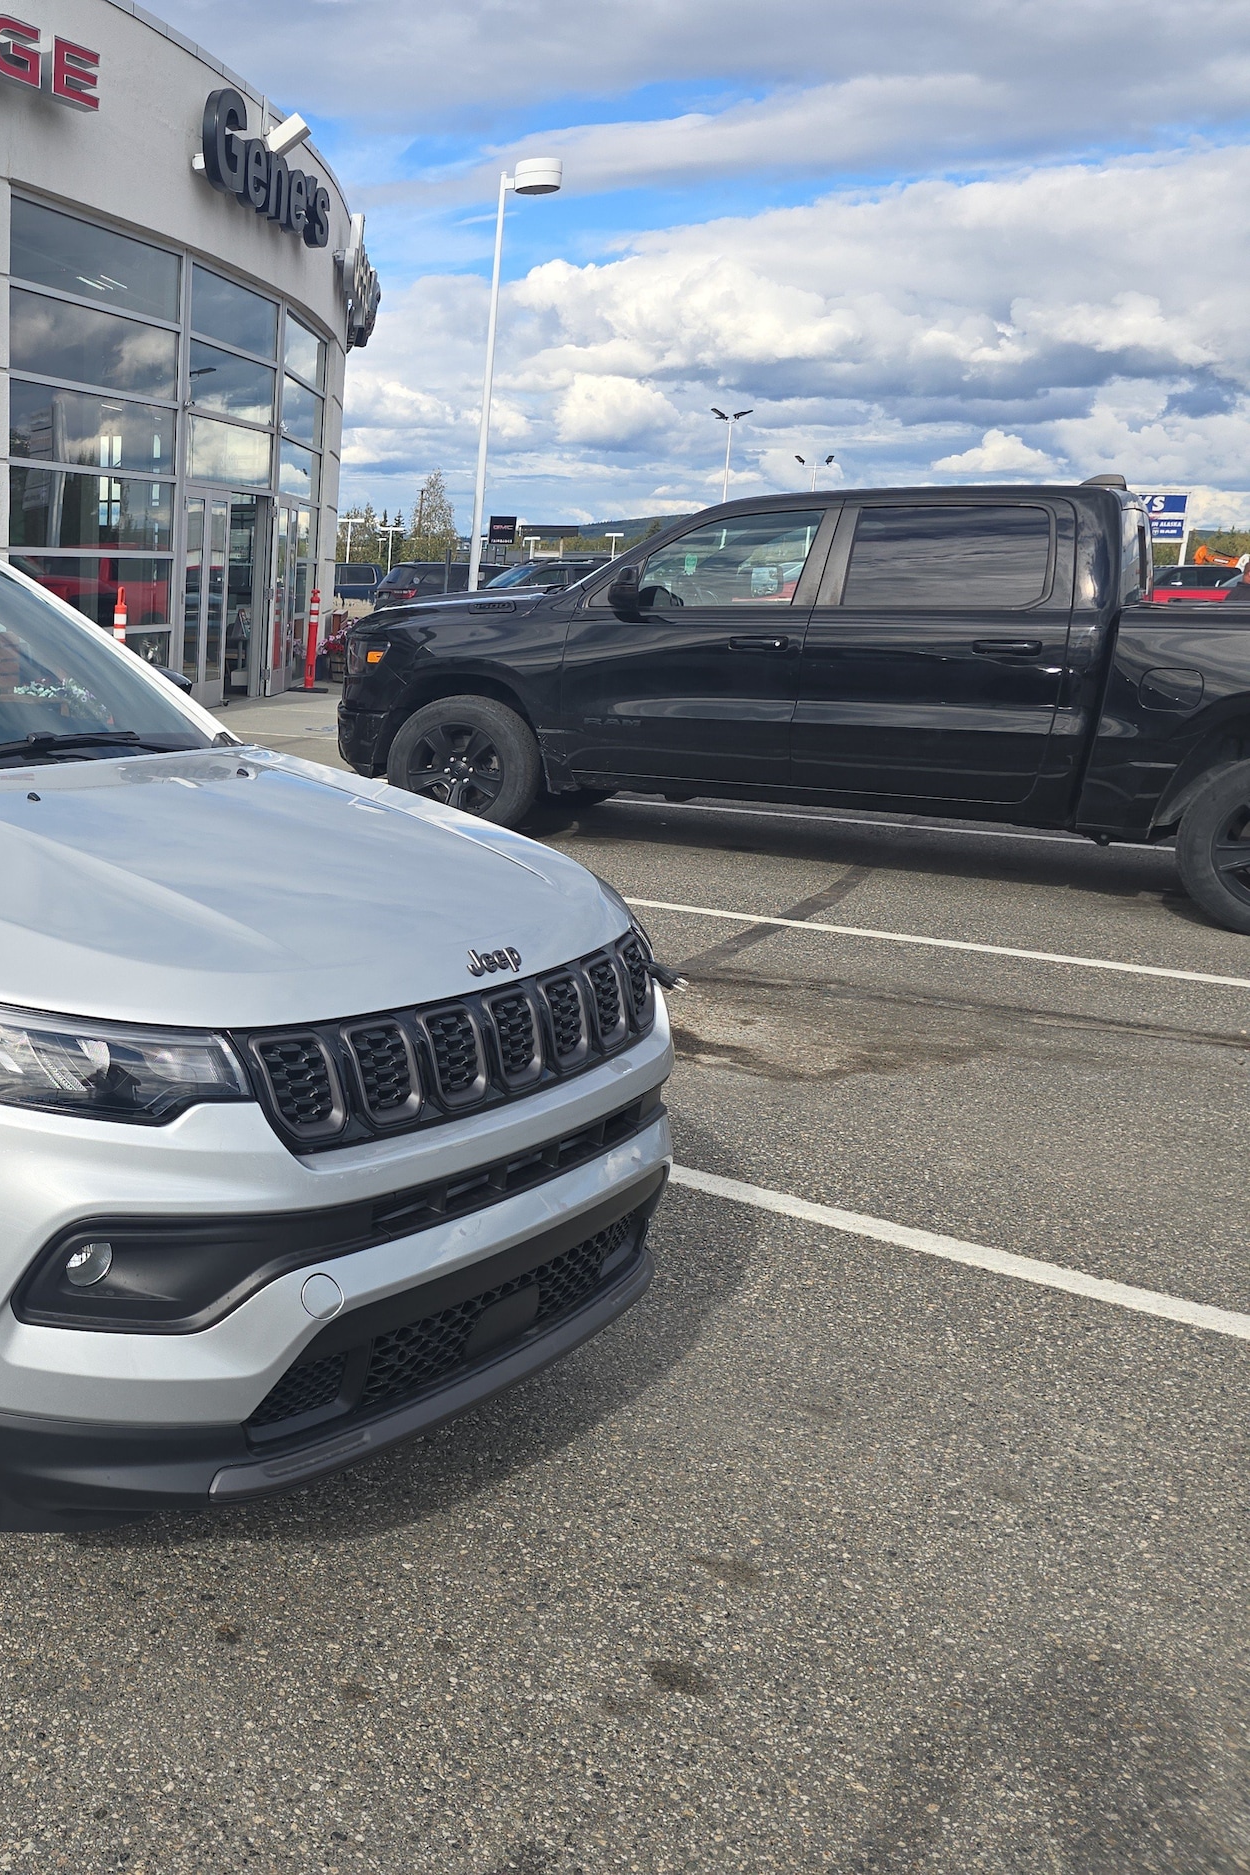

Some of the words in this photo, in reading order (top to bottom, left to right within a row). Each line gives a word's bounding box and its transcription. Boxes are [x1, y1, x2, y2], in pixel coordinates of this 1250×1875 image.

[204, 88, 331, 249] Gene's
[583, 716, 642, 727] RAM
[466, 946, 523, 978] Jeep
